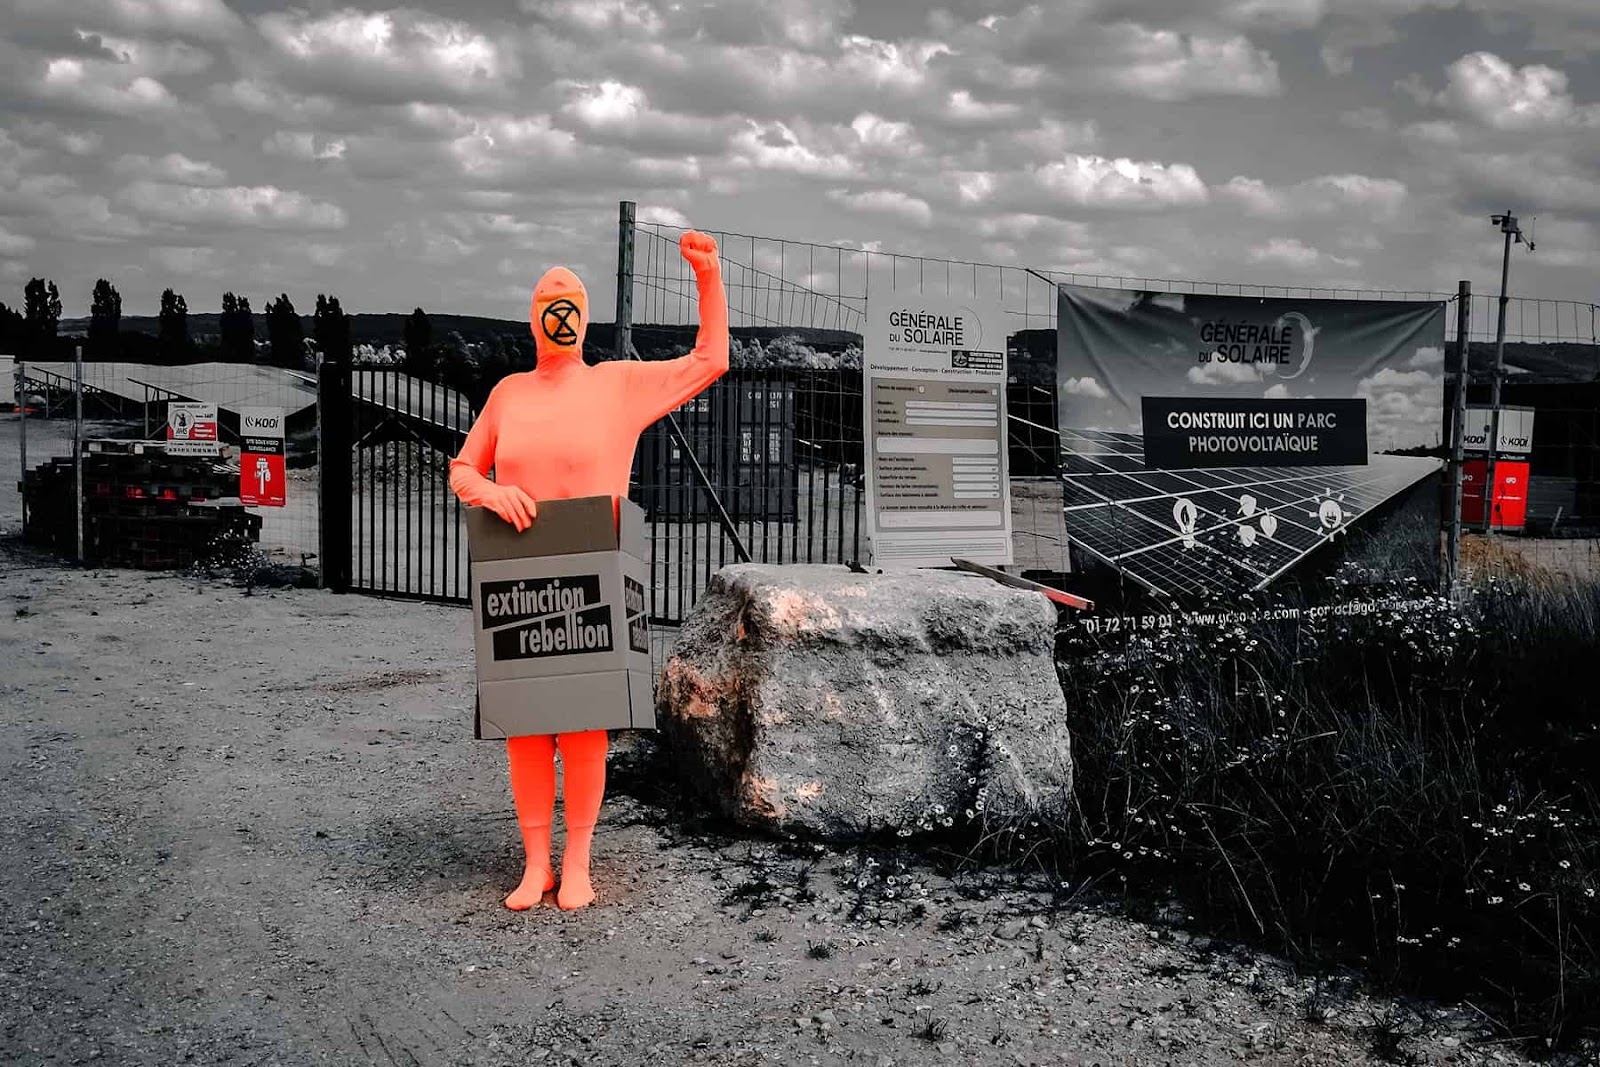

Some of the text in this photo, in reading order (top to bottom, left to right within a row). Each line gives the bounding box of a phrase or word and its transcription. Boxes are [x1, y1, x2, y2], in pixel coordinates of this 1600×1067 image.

[889, 308, 963, 330] GÉNÉRALE
[889, 329, 964, 346] DU SOLAIRE
[1200, 320, 1292, 344] GÉNÉRALE
[1198, 344, 1291, 364] DU SOLAIRE
[1167, 412, 1337, 429] CONSTRUIT ICI UN PARC
[1188, 432, 1319, 452] PHOTOVOLTAÏQUE
[487, 579, 585, 617] extinction
[519, 612, 609, 654] rebellion
[1086, 618, 1100, 633] 01
[1104, 617, 1120, 632] 72
[1123, 616, 1136, 630] 71
[1141, 615, 1155, 629] 59
[1158, 614, 1172, 628] 01
